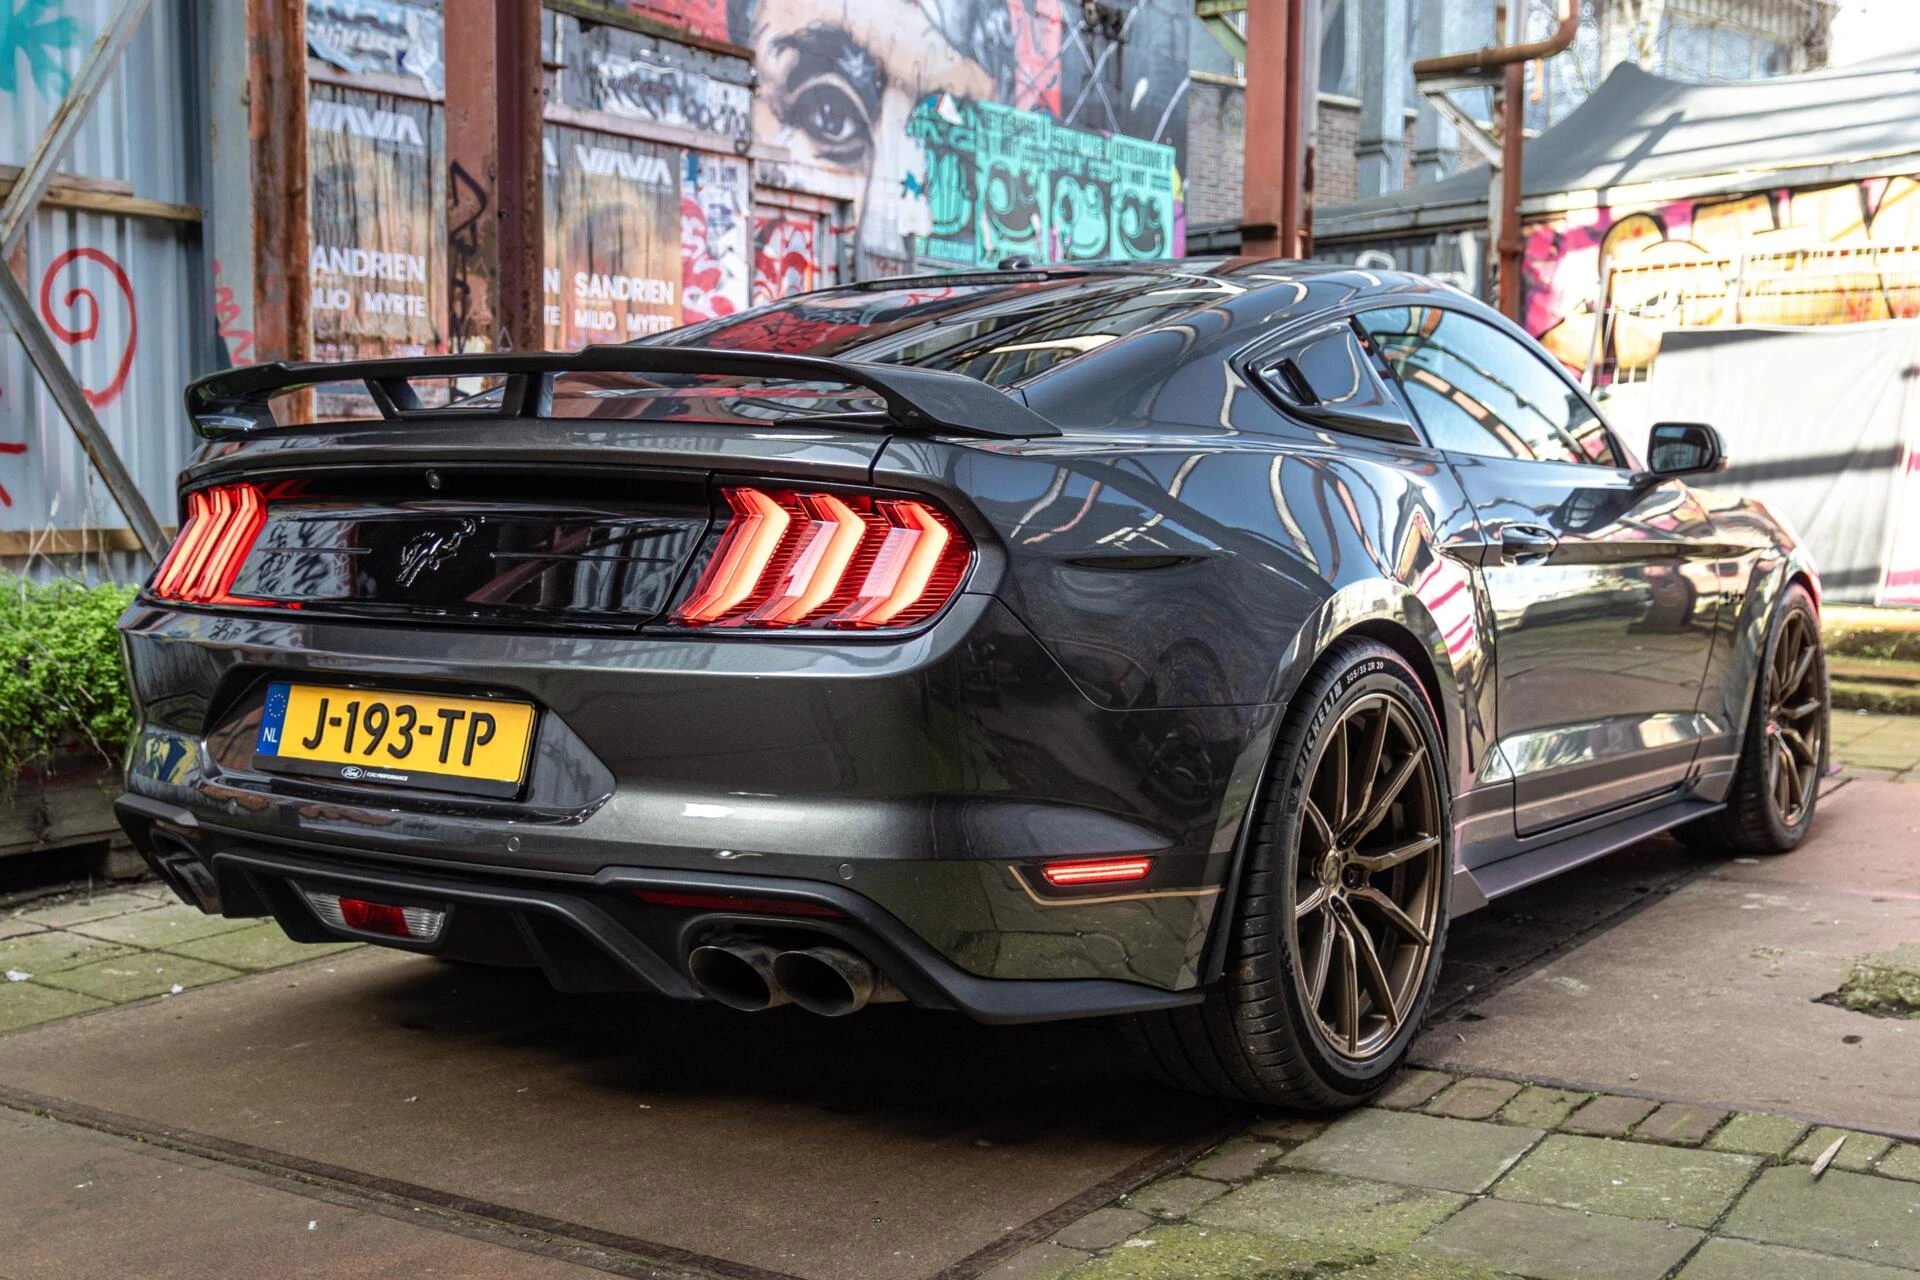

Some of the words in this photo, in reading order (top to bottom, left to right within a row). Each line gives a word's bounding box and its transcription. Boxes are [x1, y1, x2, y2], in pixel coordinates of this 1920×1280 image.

[575, 272, 674, 305] SANDRIEN
[364, 292, 425, 317] MYRTE
[575, 309, 617, 331] MILIO
[262, 727, 278, 743] NL
[302, 698, 496, 766] J-193-TP
[1297, 680, 1343, 780] MICHELIN
